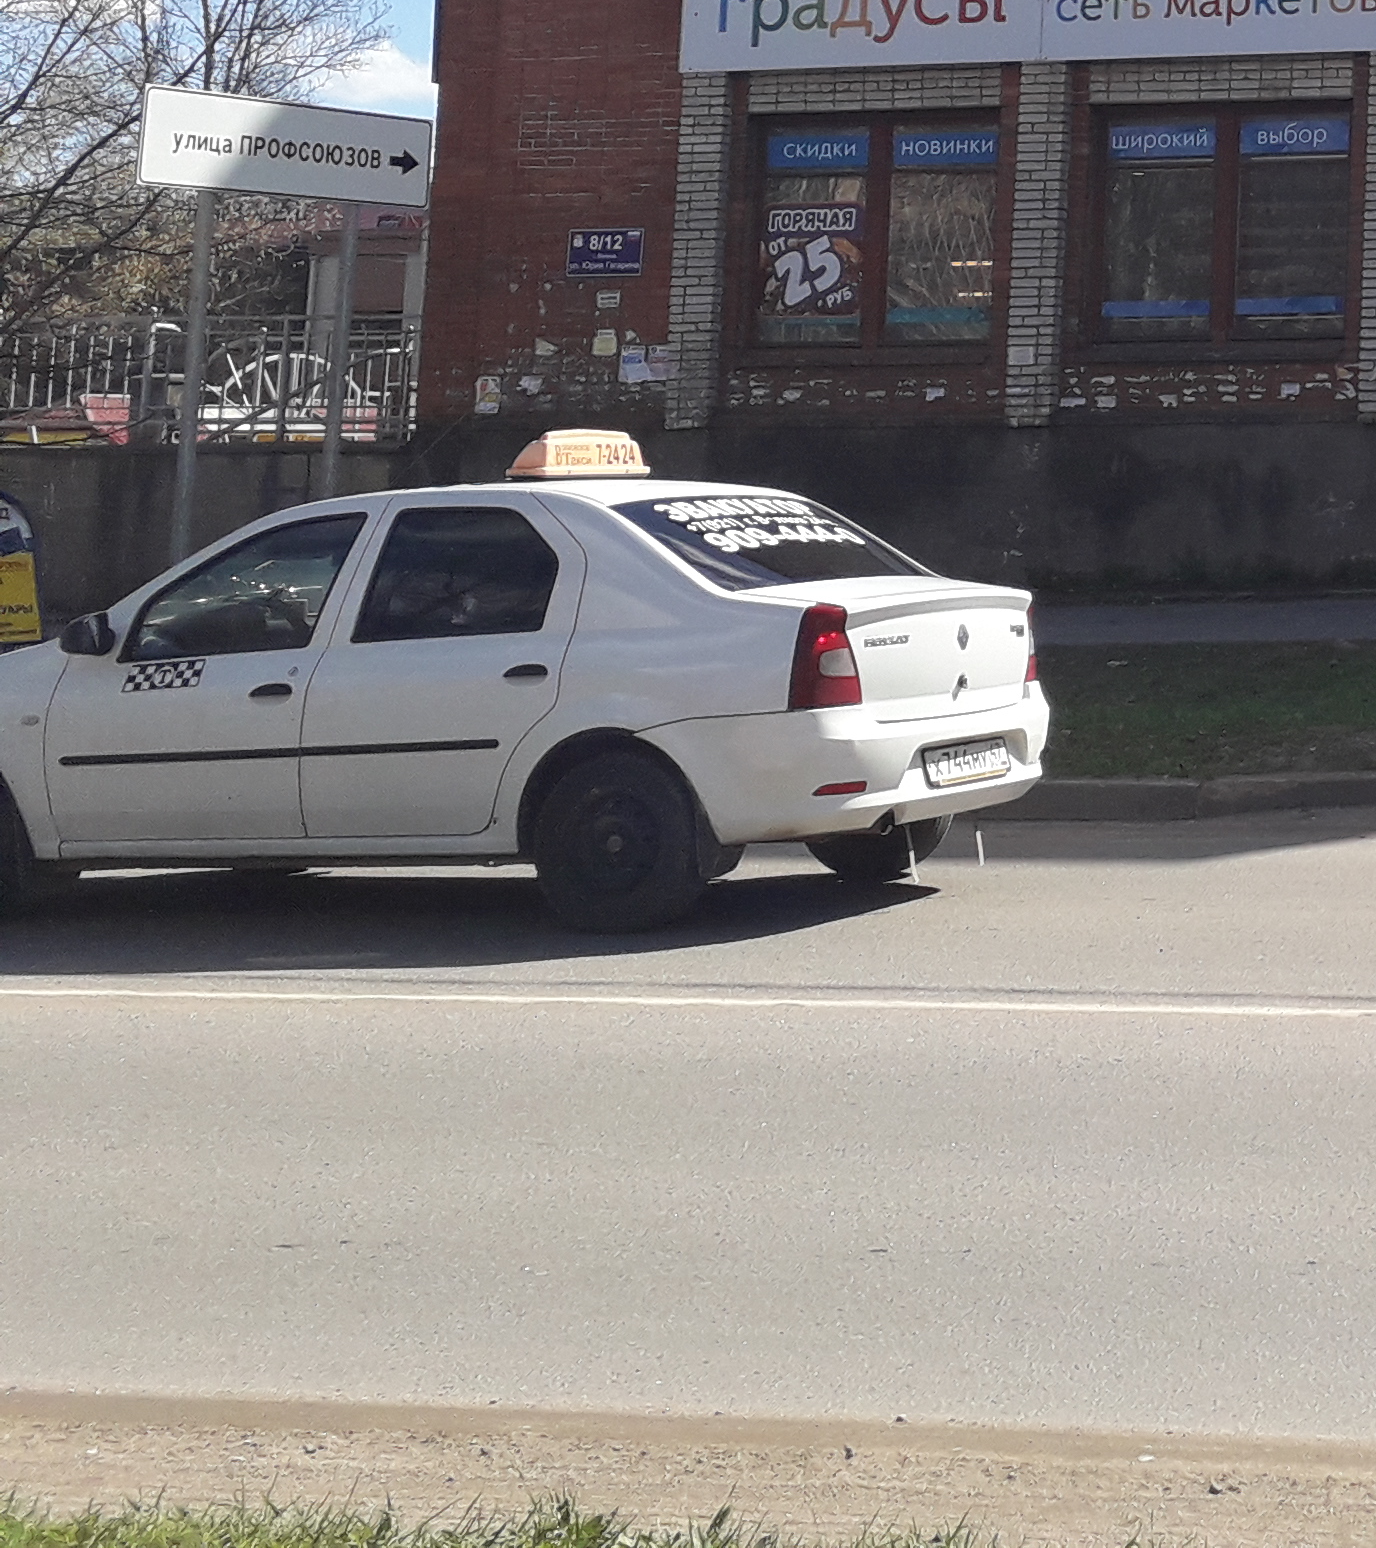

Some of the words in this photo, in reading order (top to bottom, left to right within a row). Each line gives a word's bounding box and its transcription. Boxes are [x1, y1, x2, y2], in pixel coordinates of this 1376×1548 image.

[1111, 128, 1208, 152] широкий
[1257, 122, 1328, 147] выбор
[172, 130, 233, 157] улица
[239, 136, 382, 171] ПРОФСОЮЗОВ
[782, 141, 857, 159] скидки
[900, 138, 994, 157] новинки
[768, 208, 856, 231] ГОРЯЧАЯ
[589, 234, 623, 250] 8/12
[768, 237, 786, 256] ОТ
[774, 235, 841, 306] 25
[653, 499, 815, 522] ЭВАКУАТОР
